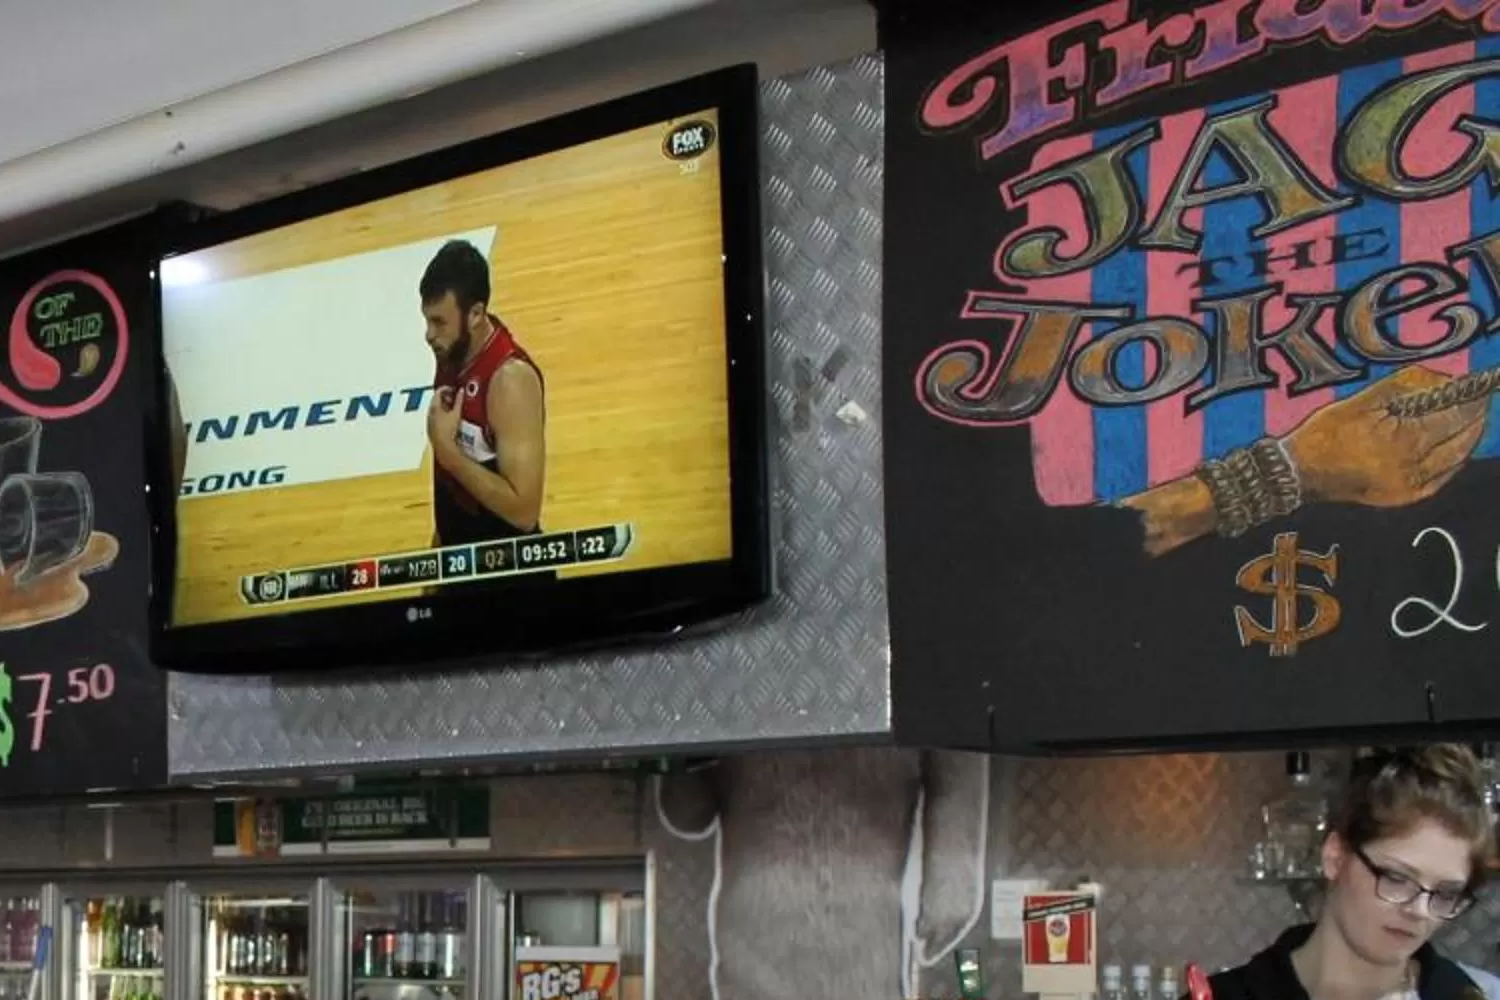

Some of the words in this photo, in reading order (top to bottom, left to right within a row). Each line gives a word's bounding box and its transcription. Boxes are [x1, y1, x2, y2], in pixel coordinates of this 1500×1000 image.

[918, 0, 1500, 160] Fri
[673, 126, 704, 151] FOX
[1176, 227, 1390, 288] THE
[34, 291, 76, 320] OF
[39, 312, 104, 349] THE
[185, 385, 435, 443] NMENT
[448, 555, 466, 573] 20
[485, 550, 505, 569] Q2
[522, 541, 567, 563] 09:52
[1390, 526, 1500, 638] 2
